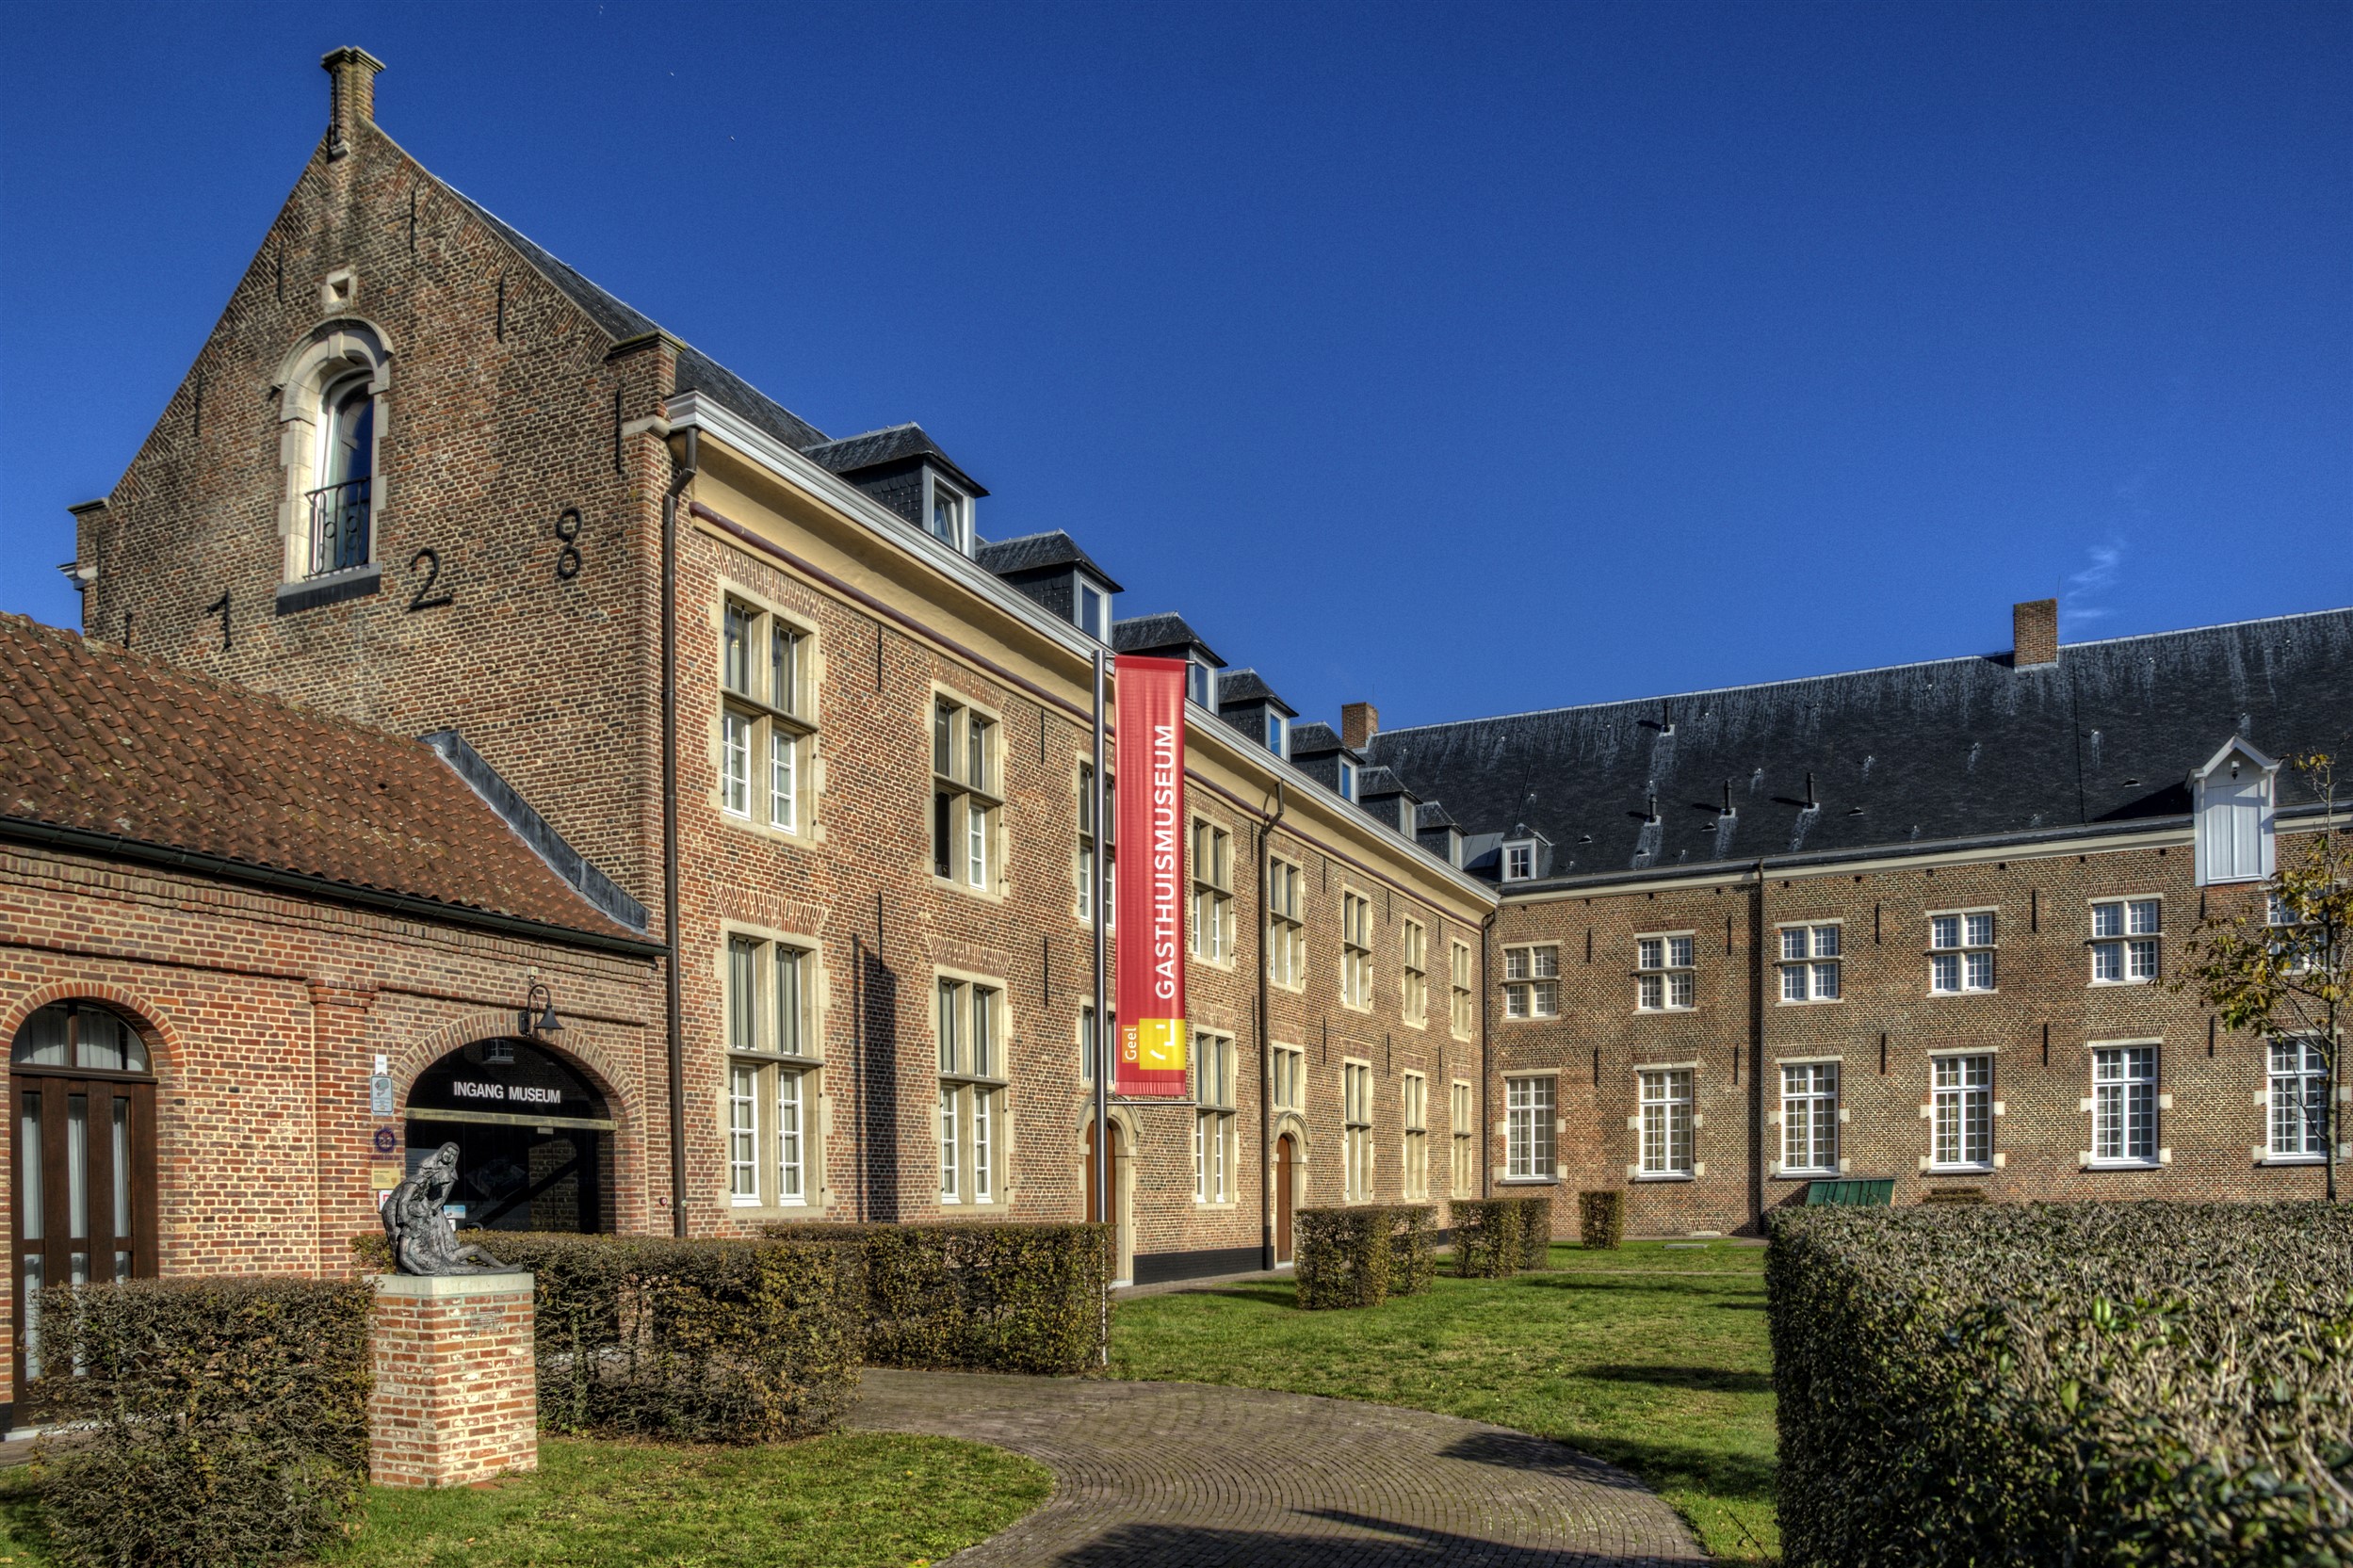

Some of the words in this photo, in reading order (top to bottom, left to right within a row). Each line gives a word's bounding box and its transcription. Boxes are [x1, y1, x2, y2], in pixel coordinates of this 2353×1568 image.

[1154, 725, 1176, 999] GASTHUISMUSEUM
[1124, 1026, 1138, 1061] Geel
[453, 1081, 505, 1100] INGANG
[509, 1086, 561, 1104] MUSEUM
